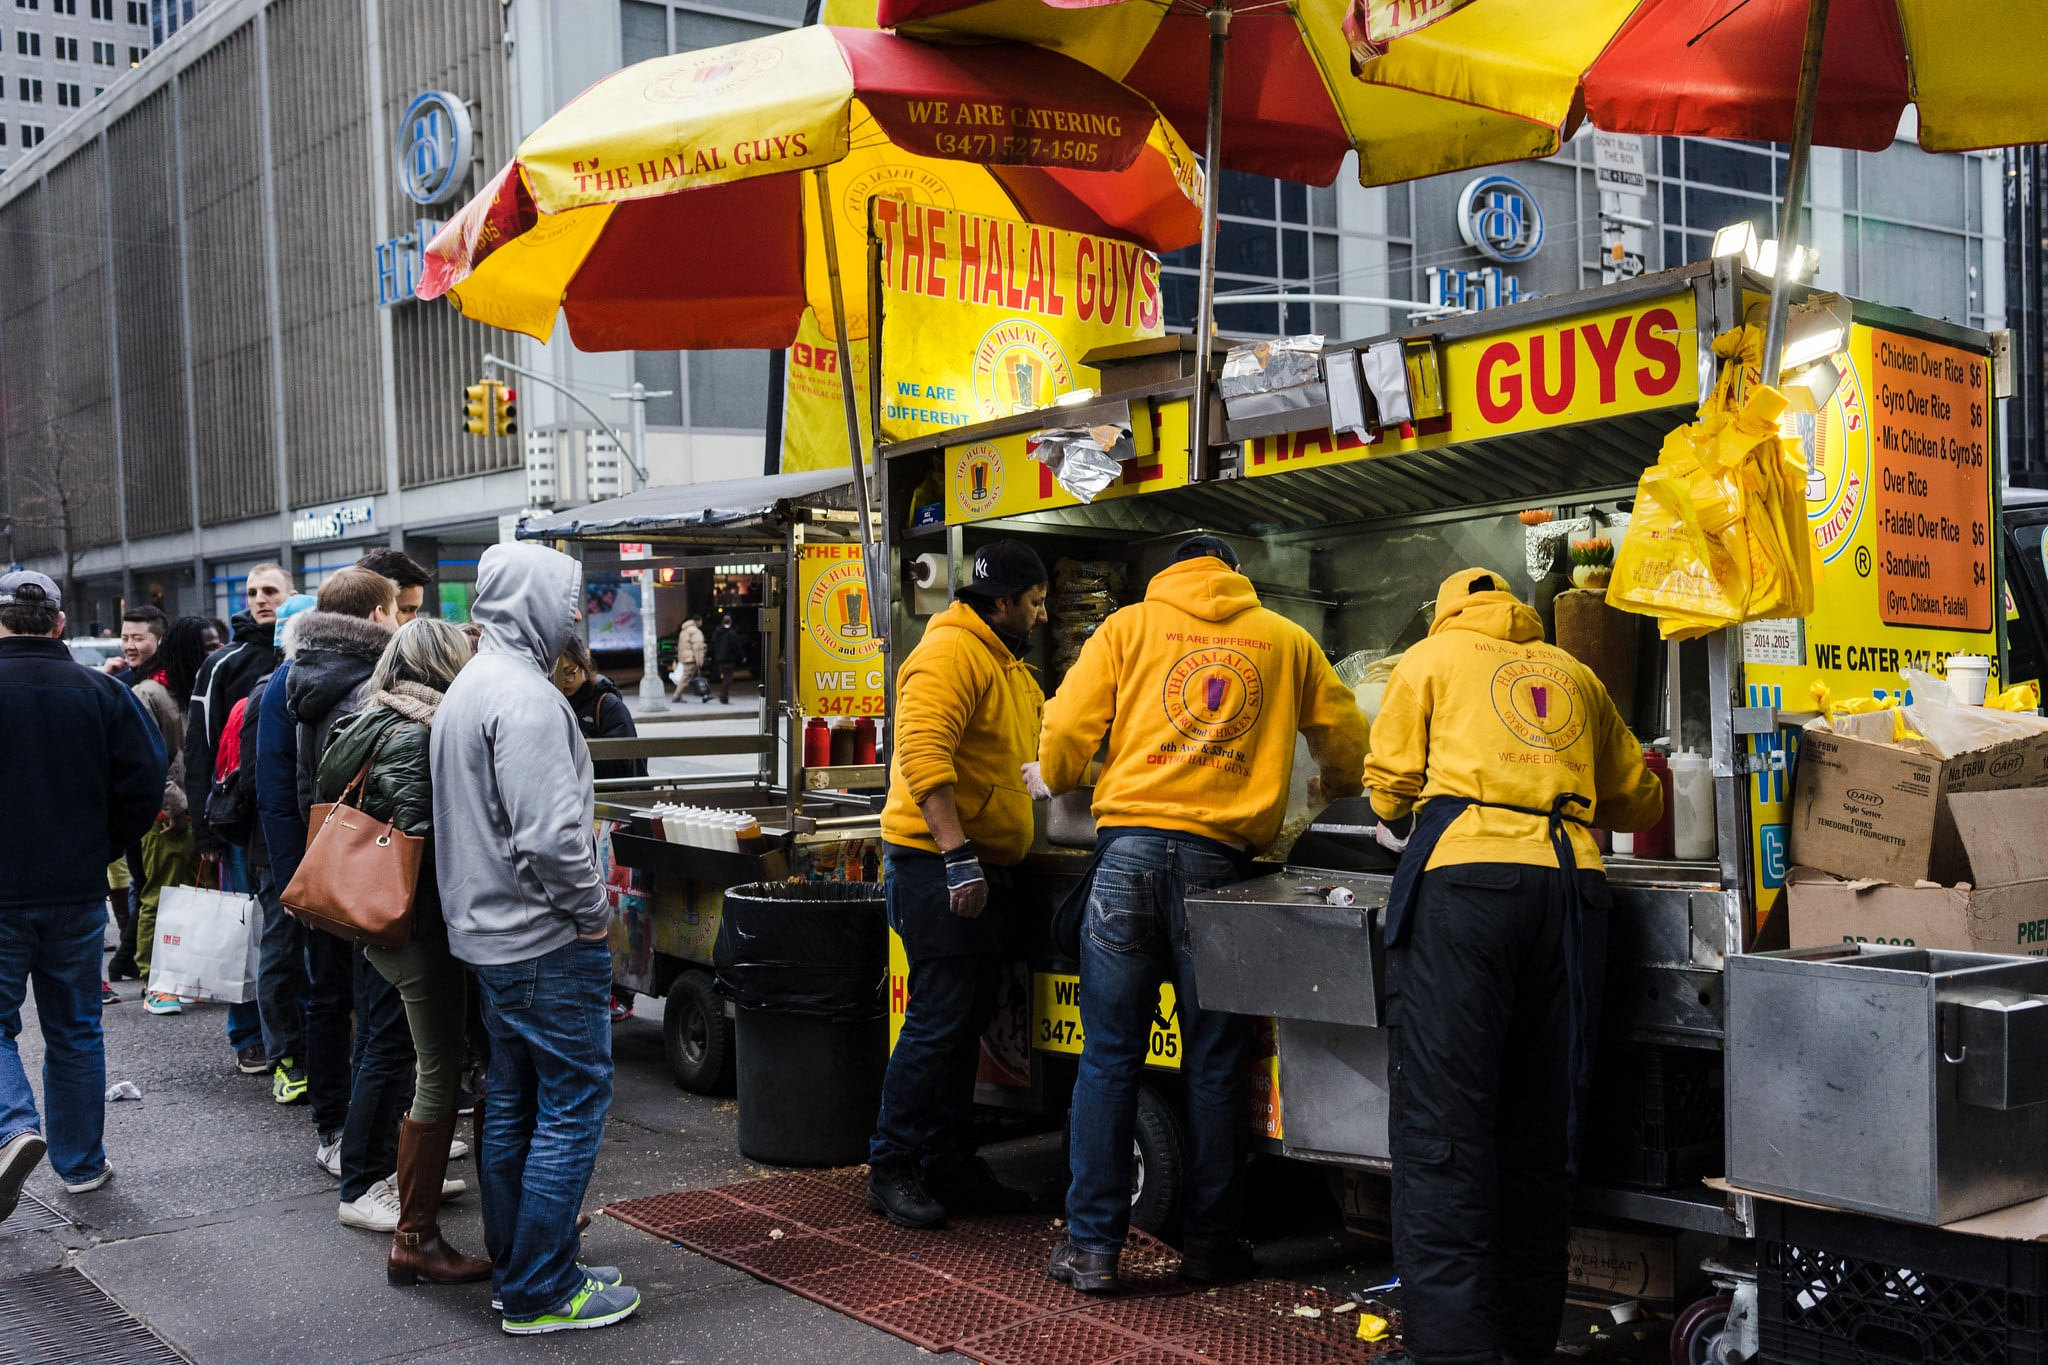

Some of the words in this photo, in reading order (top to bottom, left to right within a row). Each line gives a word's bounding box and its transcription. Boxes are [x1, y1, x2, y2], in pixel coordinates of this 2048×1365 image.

[907, 101, 949, 124] WE
[955, 103, 1005, 127] ARE
[1010, 107, 1122, 137] CATERING
[935, 132, 996, 156] (347)
[1003, 136, 1099, 163] 527-1505
[1604, 152, 1618, 162] THE
[1620, 155, 1635, 165] BOX
[1618, 140, 1639, 153] BLOCK
[574, 166, 633, 192] THE
[637, 146, 727, 185] HALAL
[733, 132, 808, 166] GUYS
[877, 198, 947, 298] THE
[959, 212, 1064, 317] HALAL
[1075, 236, 1159, 330] GUYS
[978, 340, 997, 373] THE
[996, 326, 1038, 345] HALAL
[1042, 341, 1068, 385] GUYS
[1476, 309, 1682, 424] GUYS
[1881, 342, 1918, 373] Chicken
[1921, 352, 1942, 378] Over
[1945, 359, 1963, 383] Rice
[1970, 363, 1982, 388] $6
[897, 381, 920, 397] WE
[925, 387, 956, 401] ARE
[1829, 353, 1862, 432] UYS
[887, 405, 970, 426] DIFFERENT
[1882, 384, 1904, 416] Gyro
[1908, 389, 1929, 415] Over
[1931, 395, 1950, 420] Rice
[1971, 403, 1982, 428] $6
[1883, 425, 1899, 451] Mix
[1902, 429, 1938, 458] Chicken
[1941, 437, 1946, 460] &
[957, 461, 967, 479] THE
[966, 445, 986, 460] HALAL
[988, 449, 1001, 473] GUYS
[1883, 467, 1905, 492] Over
[1908, 472, 1928, 497] Rice
[1815, 473, 1861, 547] CHICKEN
[1885, 509, 1915, 536] Falafel
[1917, 514, 1938, 538] Over
[1941, 519, 1960, 542] Rice
[1972, 521, 1984, 547] $6
[803, 547, 840, 559] THE
[1886, 551, 1930, 579] Sandwich
[1973, 562, 1985, 585] $4
[811, 578, 831, 607] THE
[1887, 590, 1909, 615] (Gyro,
[1912, 592, 1941, 616] Chicken,
[1943, 596, 1968, 620] Falafel)
[815, 623, 837, 649] GYRO
[838, 646, 855, 656] and
[1166, 633, 1183, 641] WE
[1186, 635, 1208, 644] ARE
[1212, 636, 1272, 651] DIFFERENT
[1754, 634, 1769, 648] 2014
[1774, 635, 1790, 649] 2015
[1815, 644, 1843, 671] WE
[1847, 645, 1899, 673] CATER
[815, 672, 857, 691] WE
[1168, 666, 1188, 697] THE
[1185, 652, 1242, 671] HALAL
[1243, 668, 1260, 707] GUYS
[1496, 663, 1539, 687] HALAL
[818, 696, 884, 715] 347-52
[1171, 702, 1193, 729] GYRO
[1192, 727, 1208, 737] and
[1208, 713, 1252, 738] CHICKEN
[1504, 710, 1528, 737] GYRO
[1529, 732, 1546, 744] and
[1549, 720, 1581, 749] HICKEN
[1160, 742, 1177, 752] 6th
[1201, 744, 1208, 754] &
[1210, 745, 1234, 759] 53rd
[1498, 752, 1516, 762] WE
[1519, 754, 1540, 764] ARE
[1993, 757, 2020, 773] DART
[1168, 755, 1186, 764] THE
[1188, 755, 1222, 770] HALAL
[1224, 762, 1250, 777] GUYS
[1913, 772, 1931, 783] 1000
[1843, 803, 1859, 814] Style
[1851, 791, 1878, 804] DART
[1818, 817, 1854, 834] TENEDORES
[1860, 828, 1906, 846] FOURCHETTES
[1851, 818, 1873, 829] FORKS
[1041, 1018, 1085, 1044] 347-
[1601, 1258, 1634, 1271] HEAT
